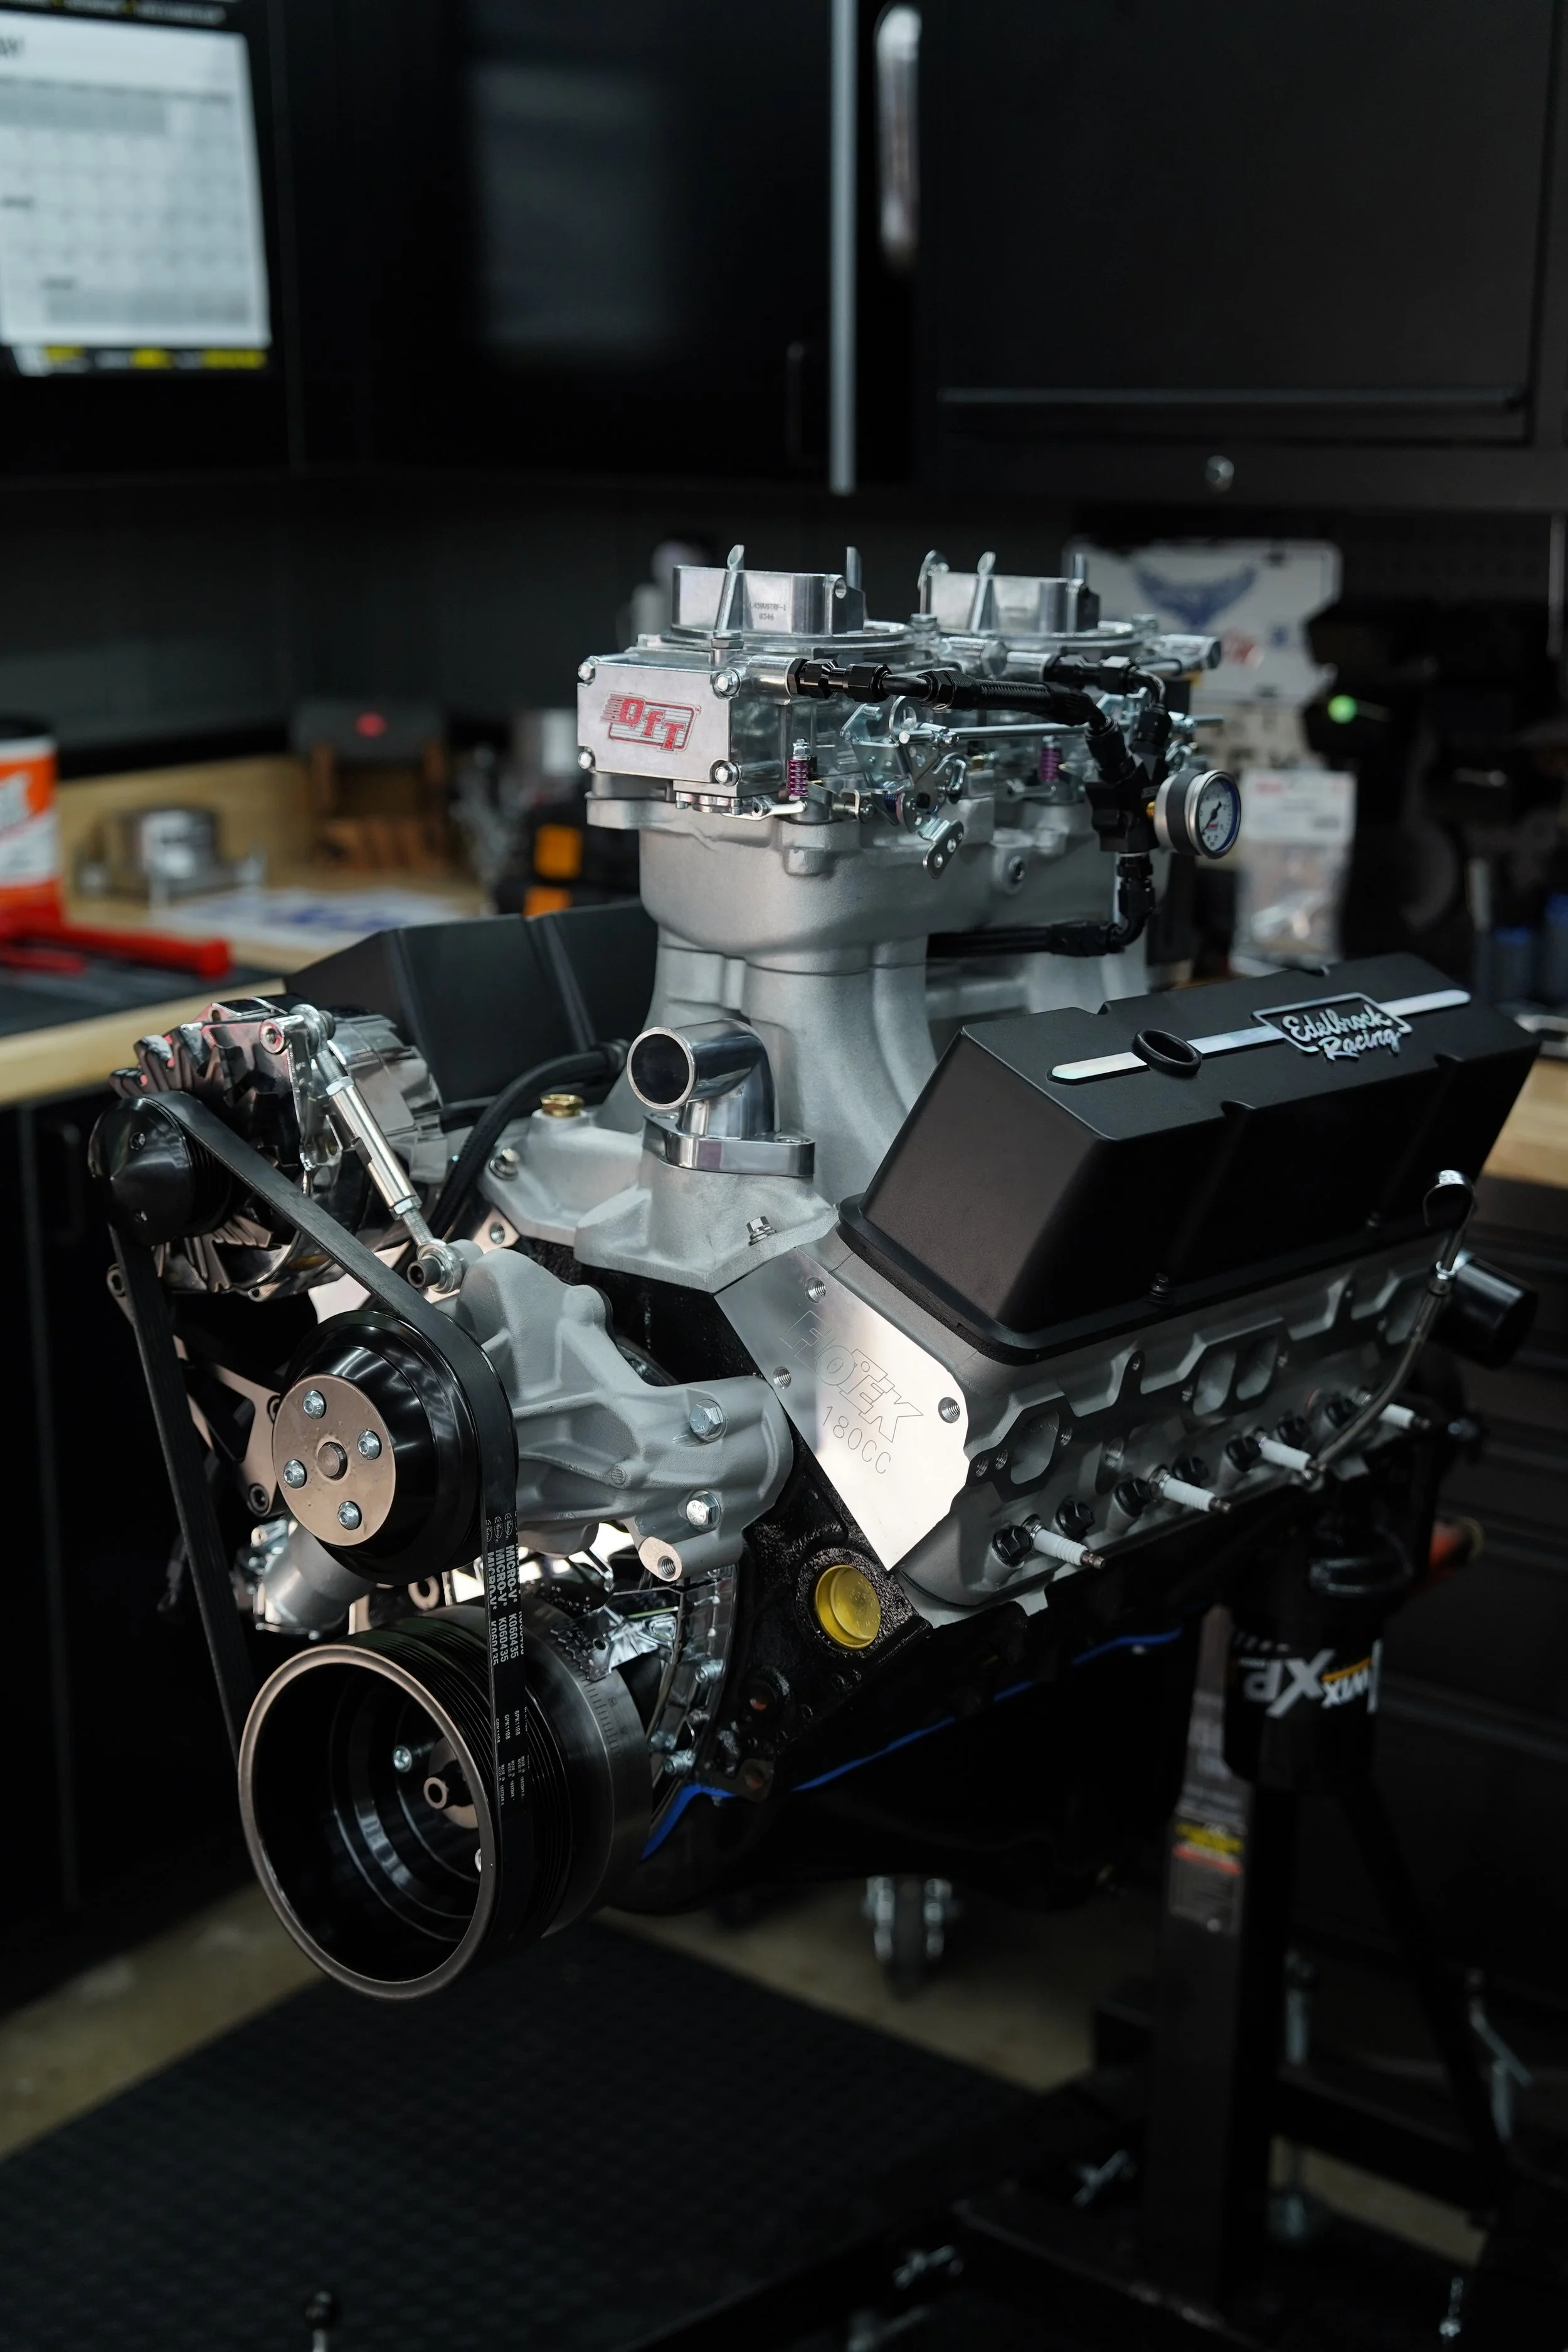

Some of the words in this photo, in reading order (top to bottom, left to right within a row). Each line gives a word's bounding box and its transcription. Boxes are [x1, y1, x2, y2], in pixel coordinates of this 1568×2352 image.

[1281, 1004, 1393, 1042] Edelbrock
[1318, 1028, 1402, 1061] Racing
[822, 1406, 891, 1474] 180CC
[499, 1617, 509, 1663] K060435
[508, 1613, 519, 1659] K060435
